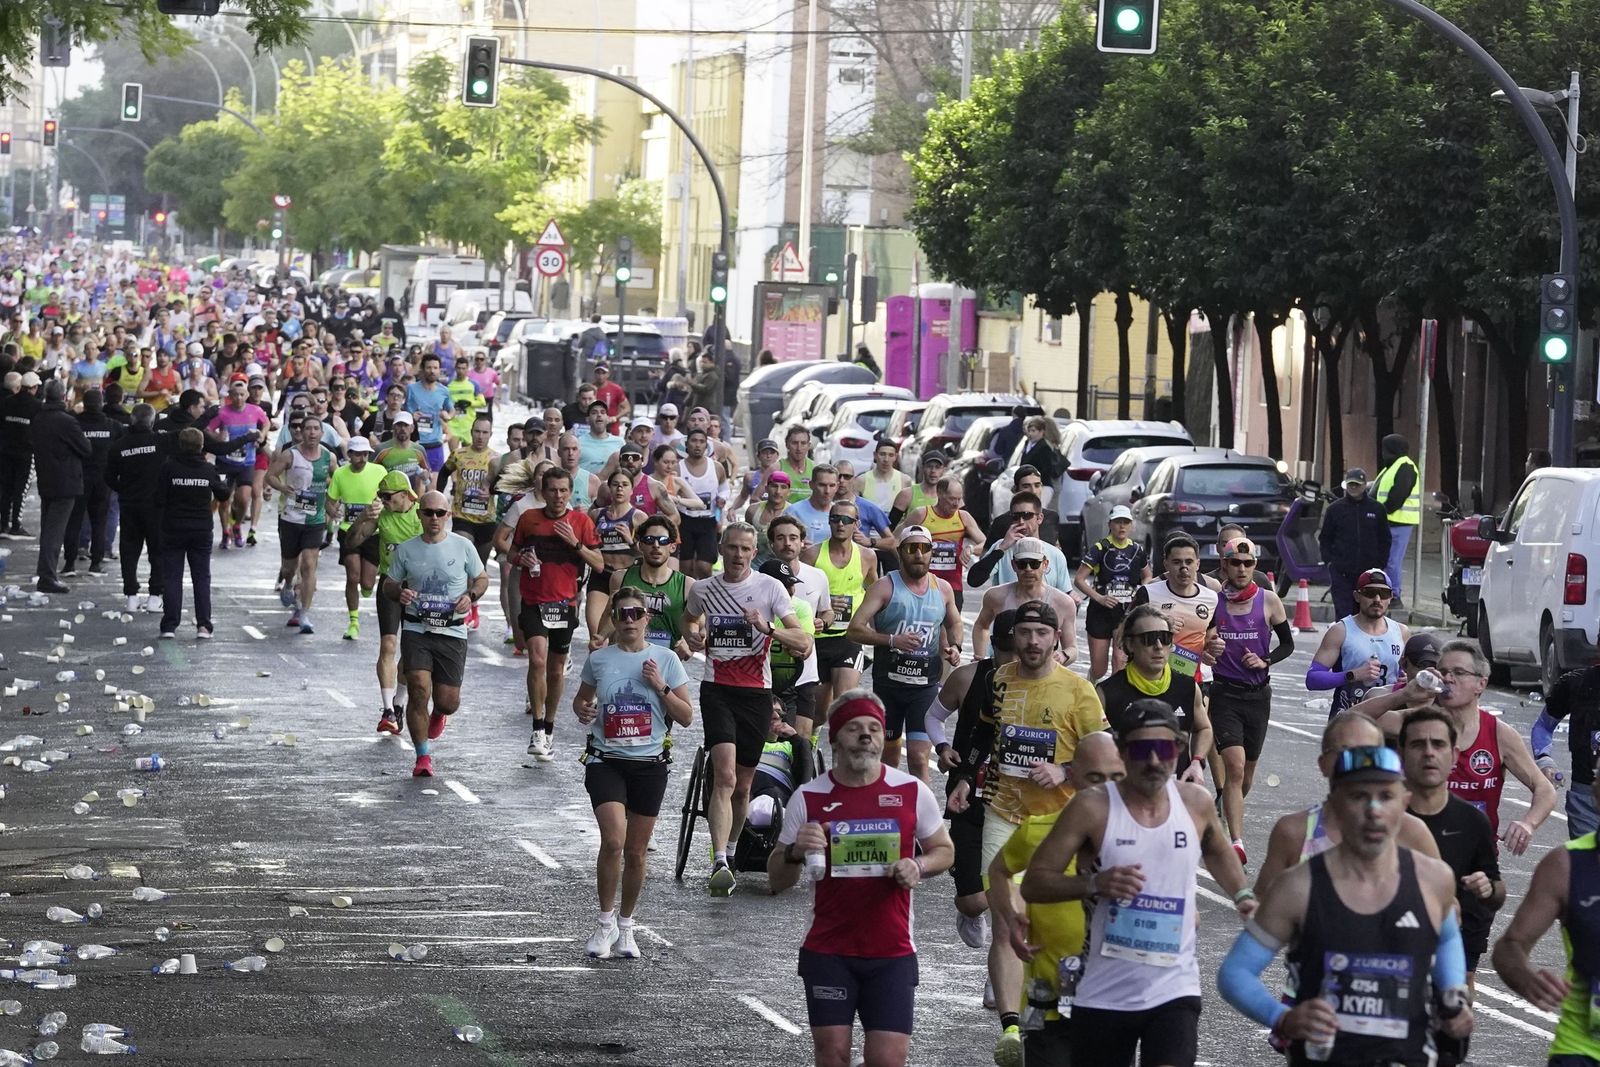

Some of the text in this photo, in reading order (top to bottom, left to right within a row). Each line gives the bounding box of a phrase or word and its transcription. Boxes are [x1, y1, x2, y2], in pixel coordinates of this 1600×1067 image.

[542, 257, 560, 267] 30
[121, 445, 156, 457] VOLUNTEER
[172, 478, 209, 487] VOLUNTEER
[723, 617, 748, 625] ZURICH
[1219, 631, 1259, 640] TOULOUSE
[714, 638, 747, 647] MARTEL
[1177, 649, 1199, 661] ZURICH
[896, 666, 922, 676] EDGAR
[619, 704, 647, 712] ZURICH
[620, 717, 635, 725] 1396
[616, 726, 640, 737] JANA
[1019, 730, 1051, 740] ZURICH
[1018, 744, 1036, 753] 4915
[1446, 776, 1498, 790] nac AC
[854, 822, 892, 832] ZURICH
[843, 849, 888, 863] JULIÁN
[1136, 898, 1178, 911] ZURICH
[1352, 957, 1404, 970] ZURICH
[1342, 994, 1384, 1016] KYRI
